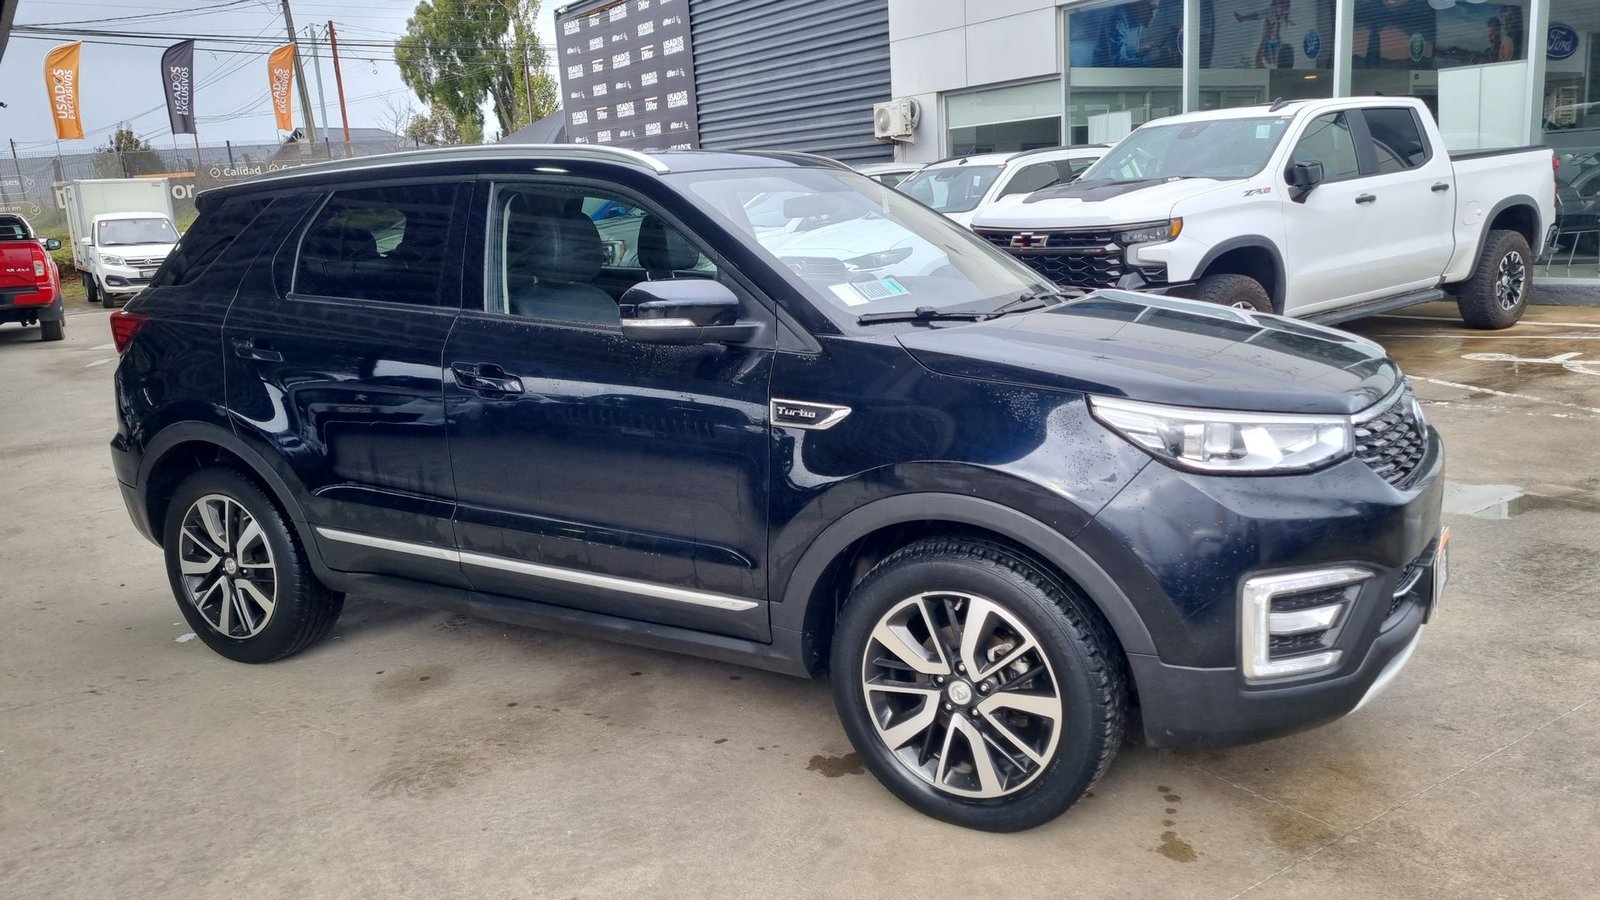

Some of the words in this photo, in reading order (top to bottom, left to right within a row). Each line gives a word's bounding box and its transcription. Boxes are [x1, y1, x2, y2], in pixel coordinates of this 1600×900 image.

[1547, 29, 1573, 51] Ford
[641, 50, 654, 60] Difor
[53, 68, 68, 119] USADOS
[64, 69, 76, 120] EXCLUSIVOS
[170, 66, 183, 115] USADOS
[181, 66, 189, 116] EXCLUSIVOS
[645, 101, 658, 112] Difor
[223, 166, 262, 177] Calidad
[777, 406, 816, 418] Turbo
